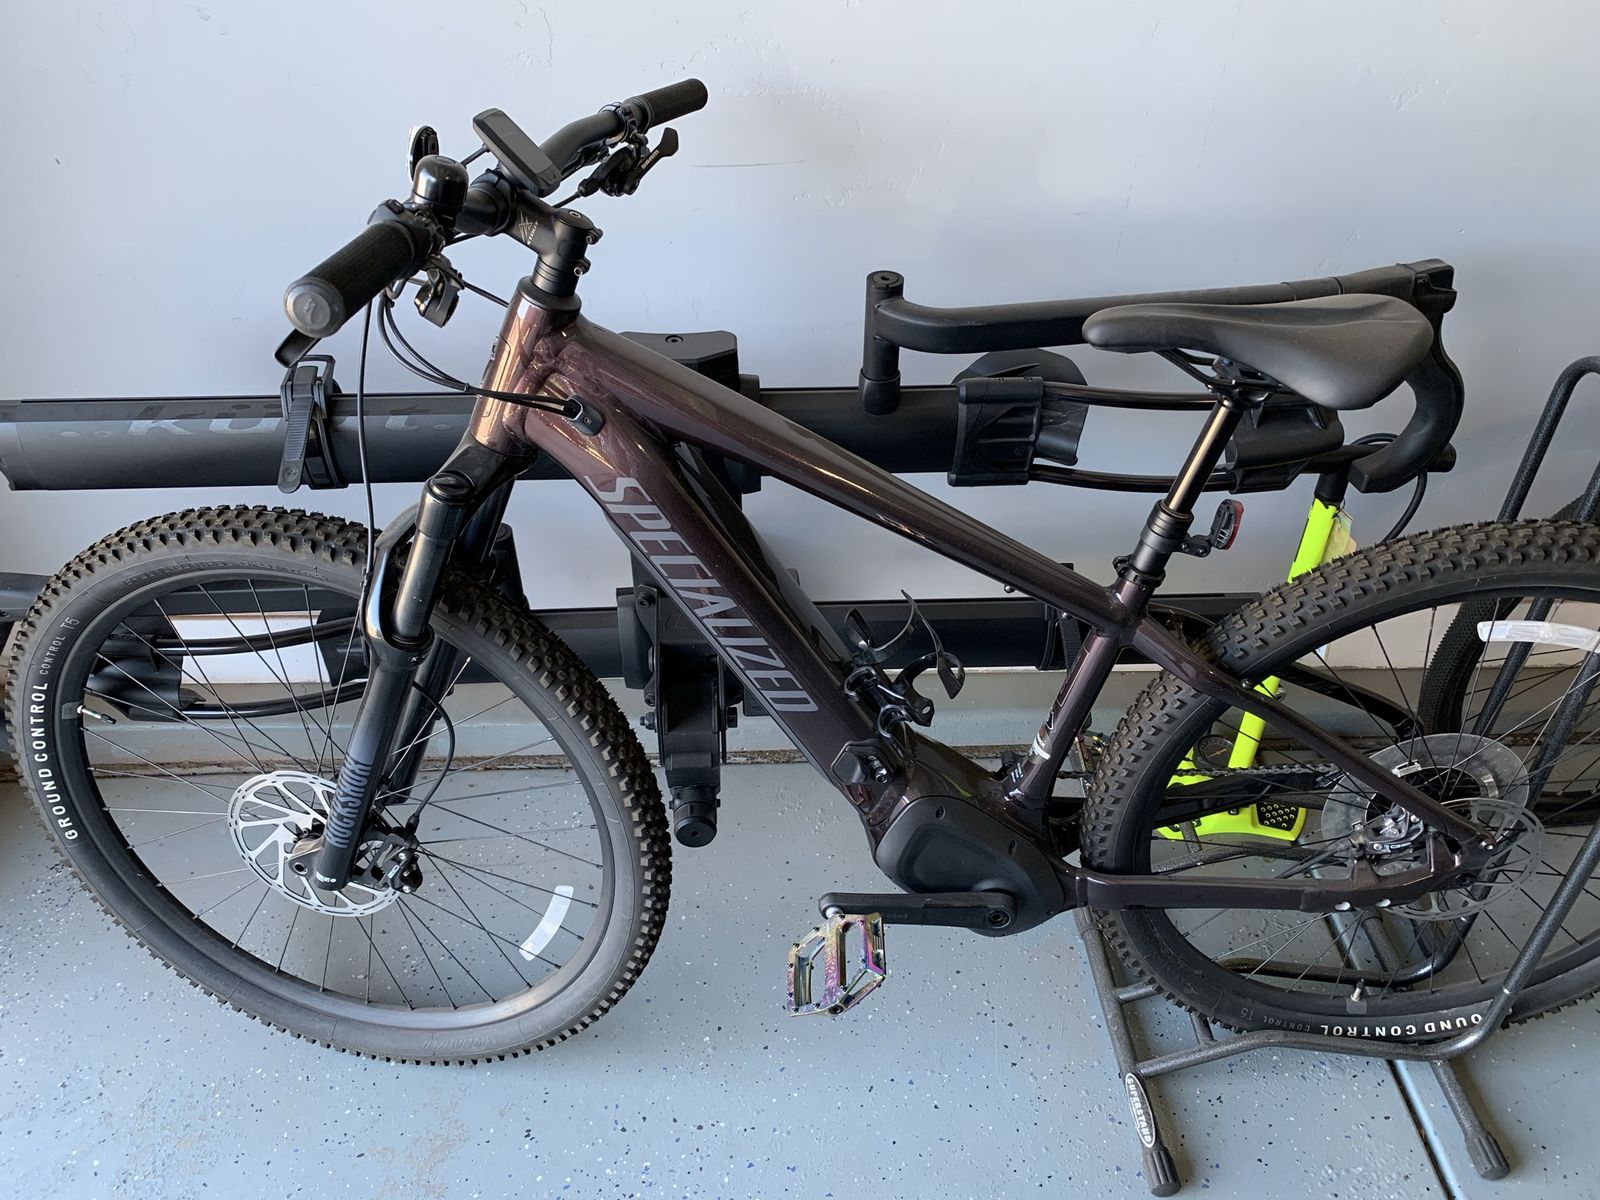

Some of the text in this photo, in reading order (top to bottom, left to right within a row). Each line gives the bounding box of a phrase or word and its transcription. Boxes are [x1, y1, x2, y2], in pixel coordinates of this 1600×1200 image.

[584, 475, 819, 712] SPECIALIZED
[39, 635, 67, 676] CONTROL
[30, 682, 49, 763] CONTROL
[38, 768, 79, 840] GROUND
[1320, 1023, 1417, 1037] CONTROL
[1424, 1012, 1483, 1034] OUND
